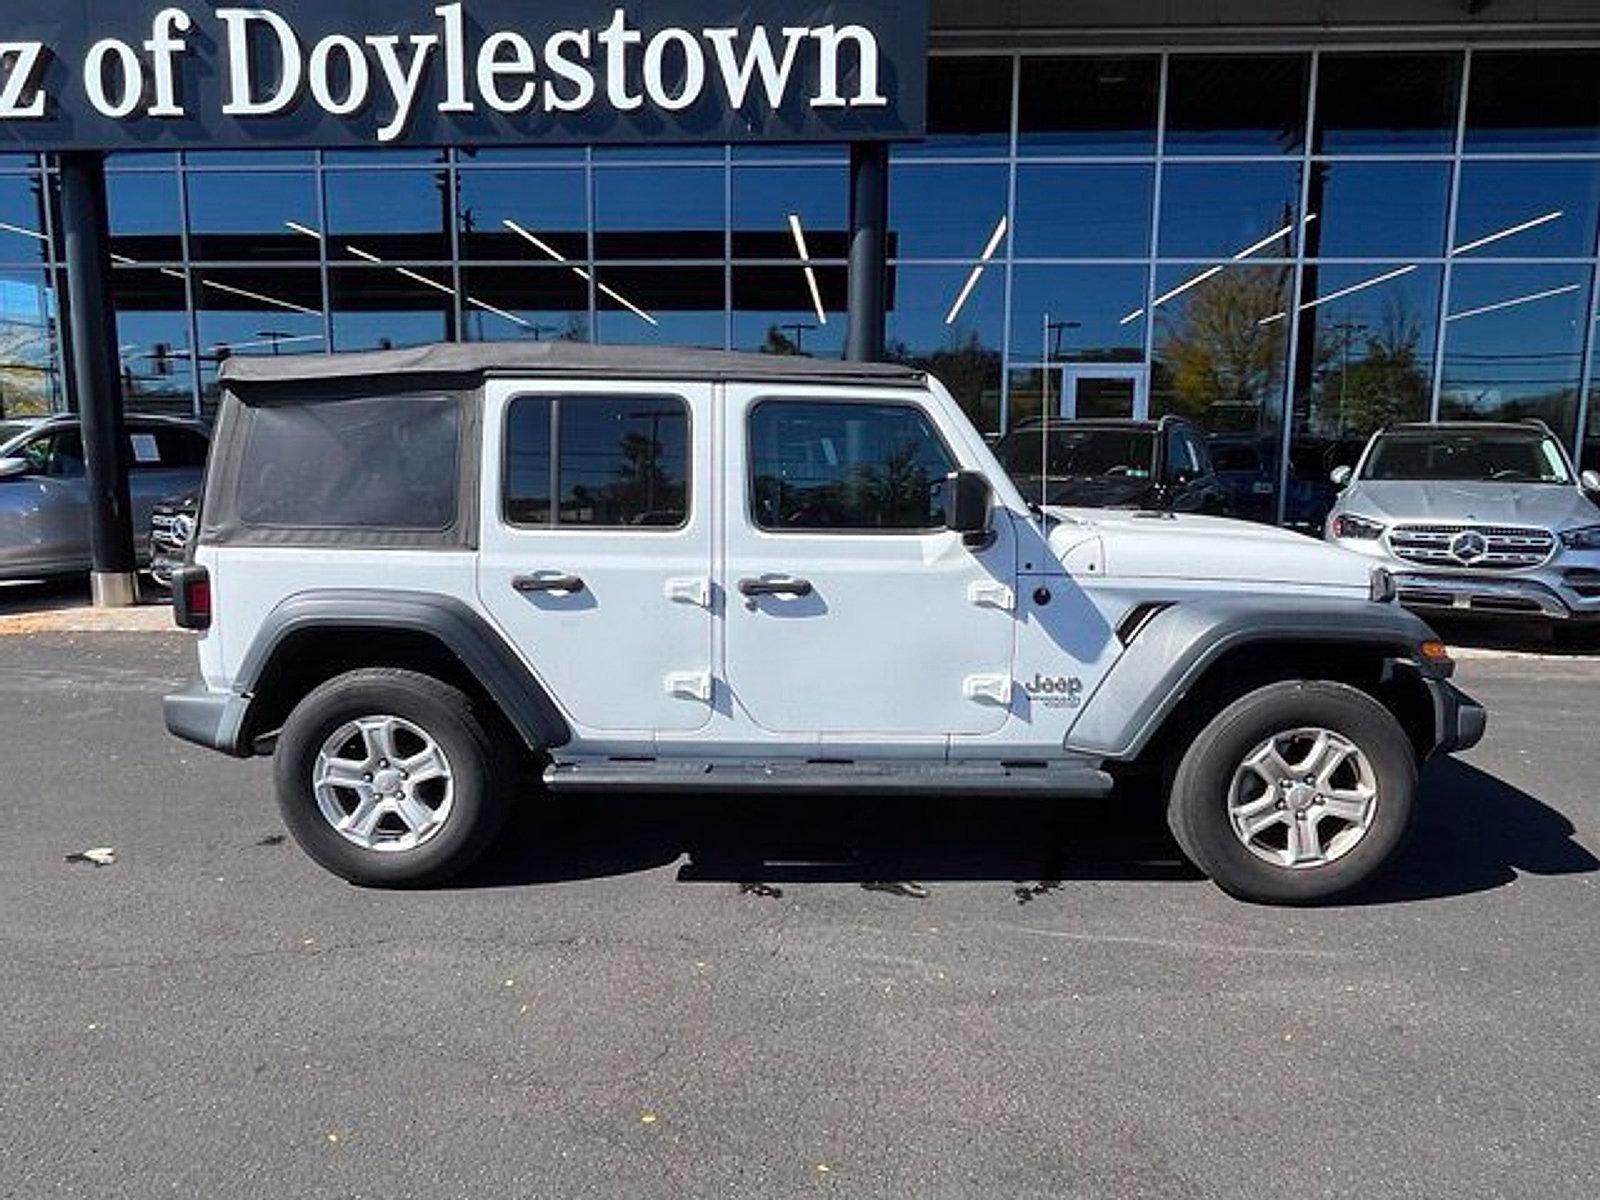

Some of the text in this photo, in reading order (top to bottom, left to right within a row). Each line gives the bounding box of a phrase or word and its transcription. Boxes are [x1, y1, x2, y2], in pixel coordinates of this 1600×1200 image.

[84, 8, 191, 117] of
[215, 2, 887, 140] Doylestown
[1025, 673, 1083, 697] Jeep
